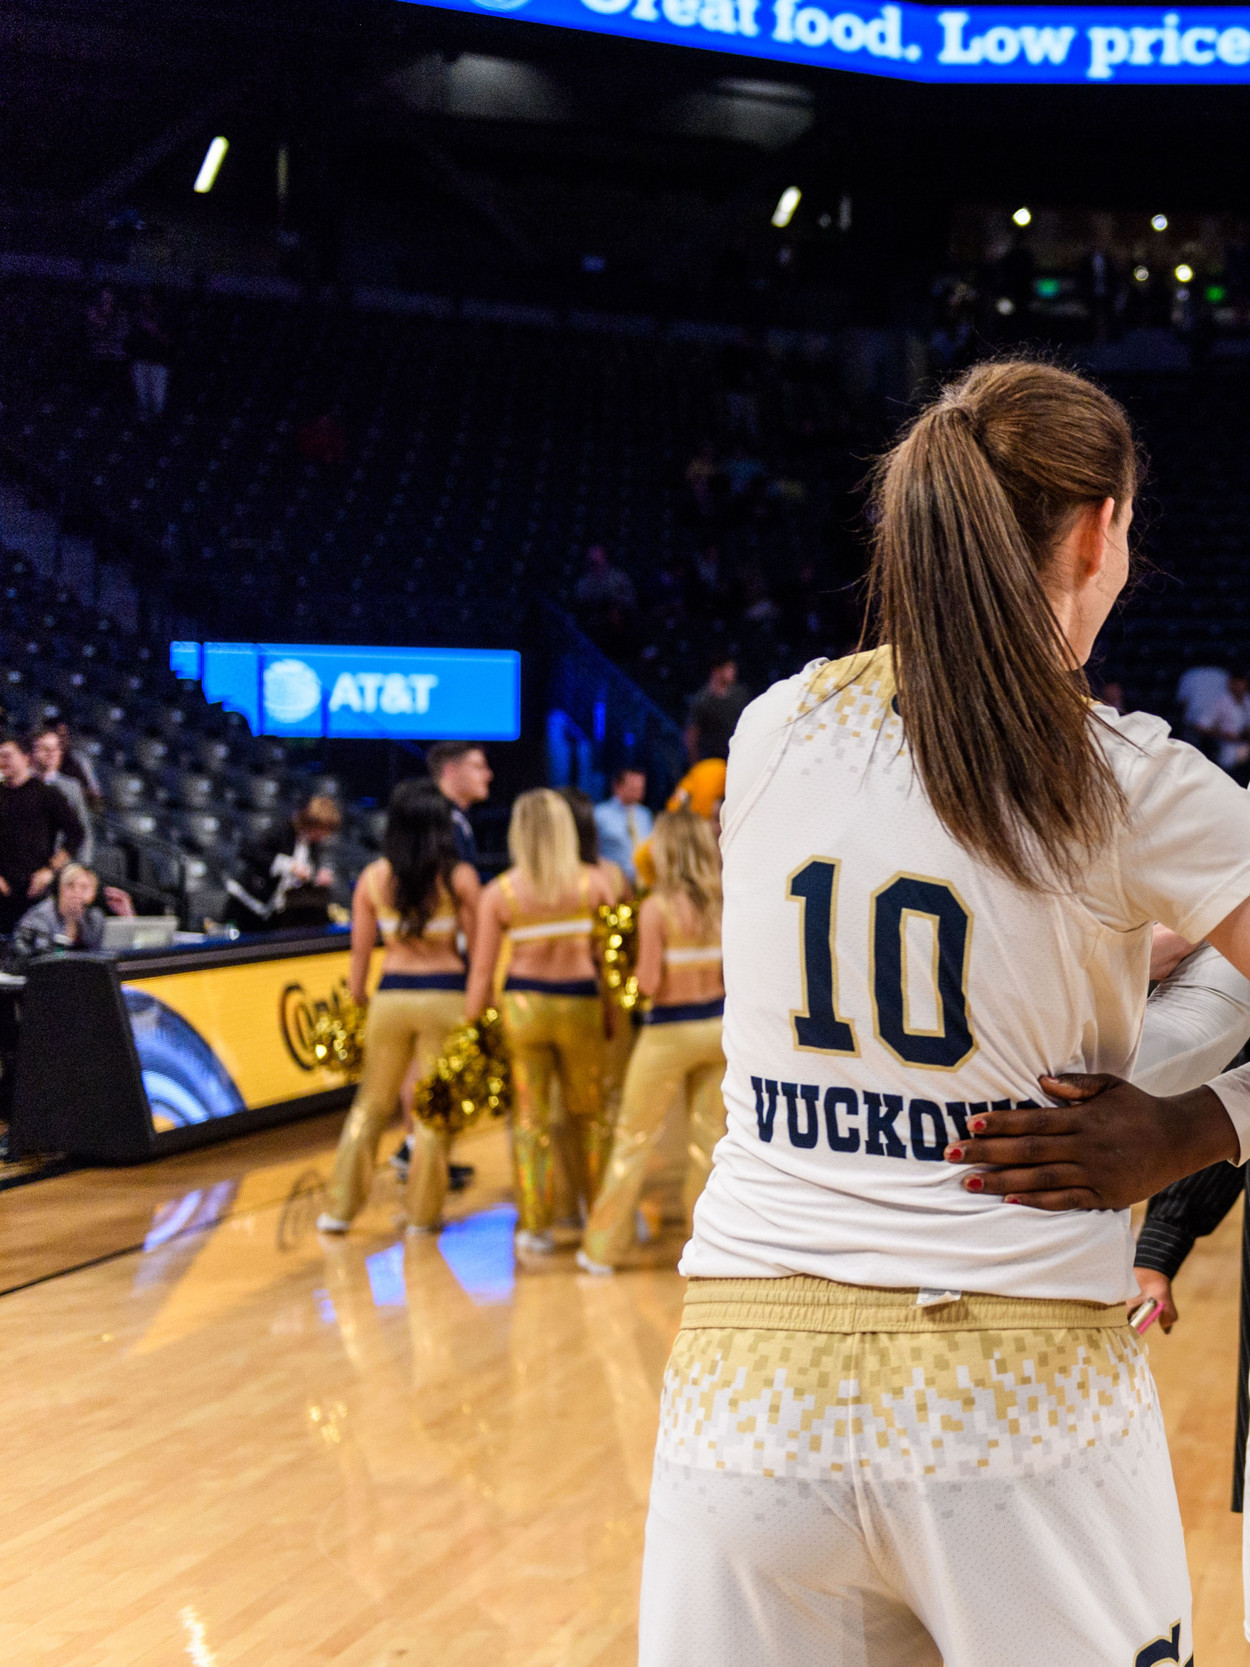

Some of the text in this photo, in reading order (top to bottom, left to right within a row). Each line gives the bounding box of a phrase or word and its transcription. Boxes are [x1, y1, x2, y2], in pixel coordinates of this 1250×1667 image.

[581, 0, 759, 37] reat
[772, 0, 922, 62] food.
[937, 10, 1077, 65] Low
[328, 671, 439, 714] AT&T
[785, 854, 979, 1073] 10
[751, 1075, 1043, 1162] VUCKOV
